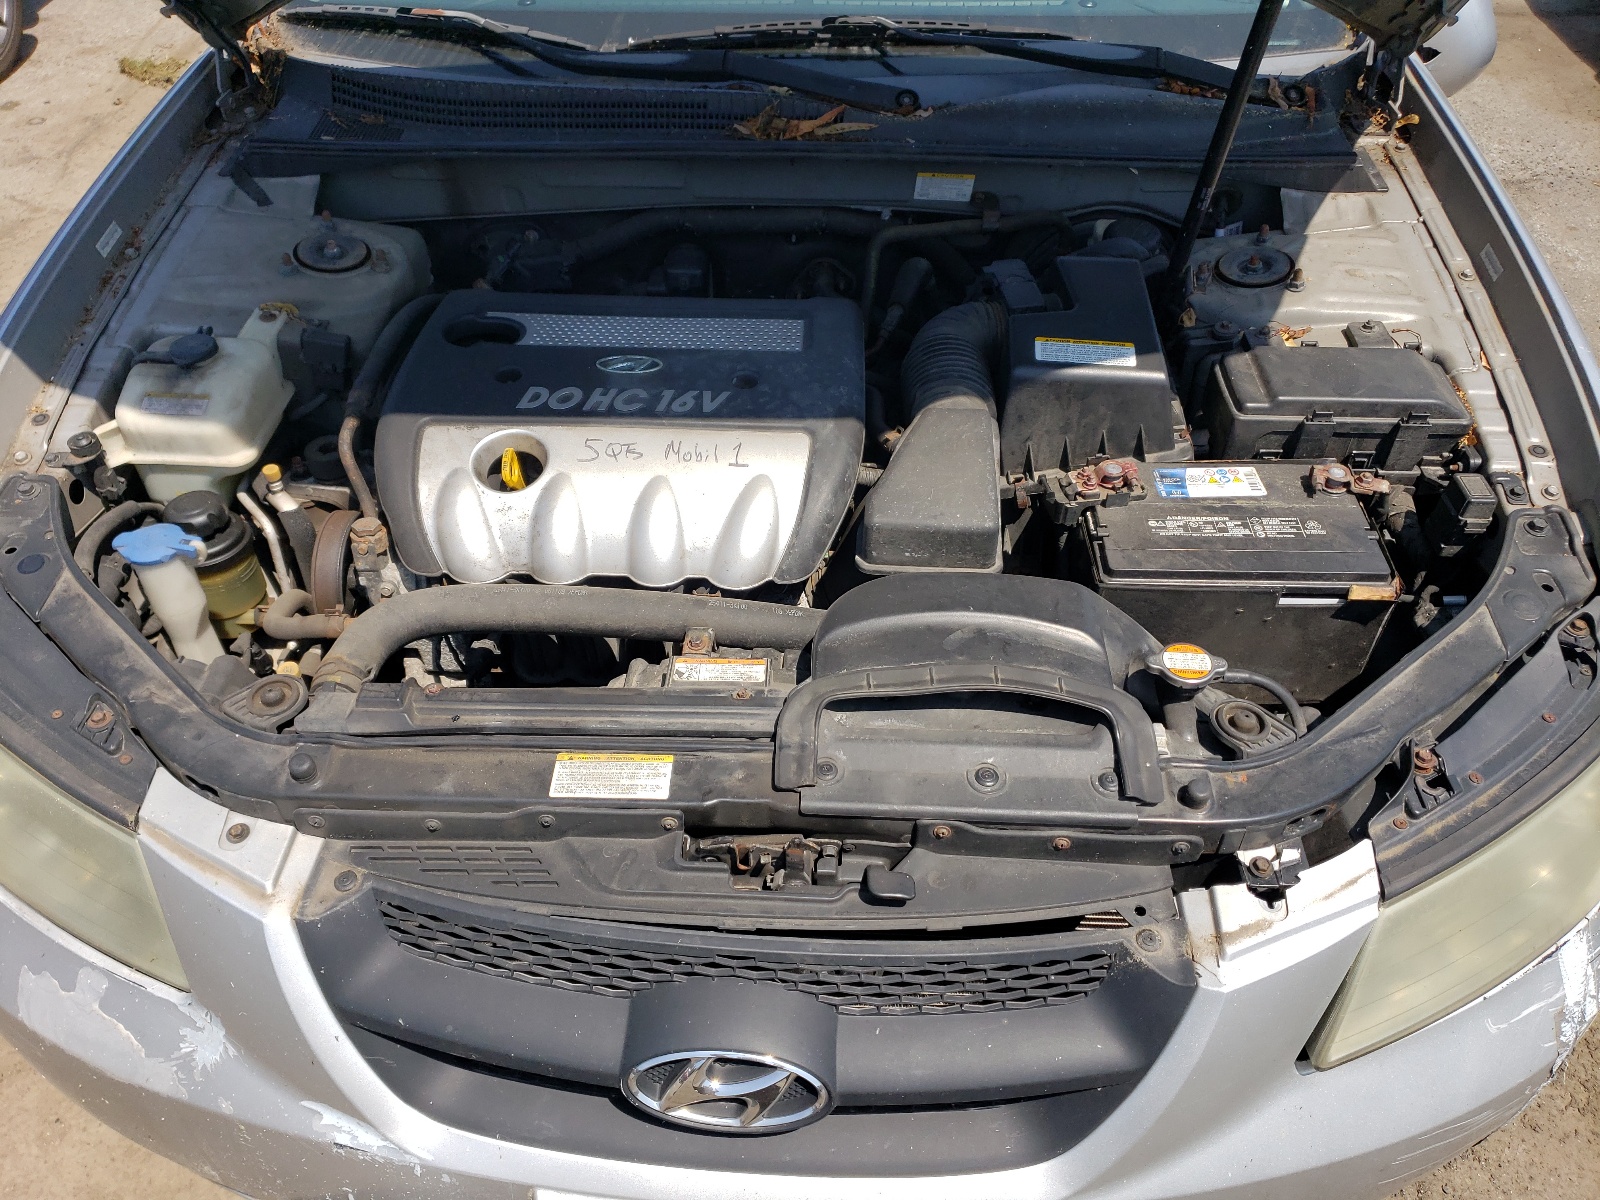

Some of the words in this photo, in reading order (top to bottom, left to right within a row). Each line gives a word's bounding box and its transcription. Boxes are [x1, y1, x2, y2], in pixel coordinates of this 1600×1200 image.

[516, 386, 649, 413] DOHC
[655, 389, 731, 413] 16V
[664, 439, 718, 463] Mobil
[728, 441, 749, 467] 1
